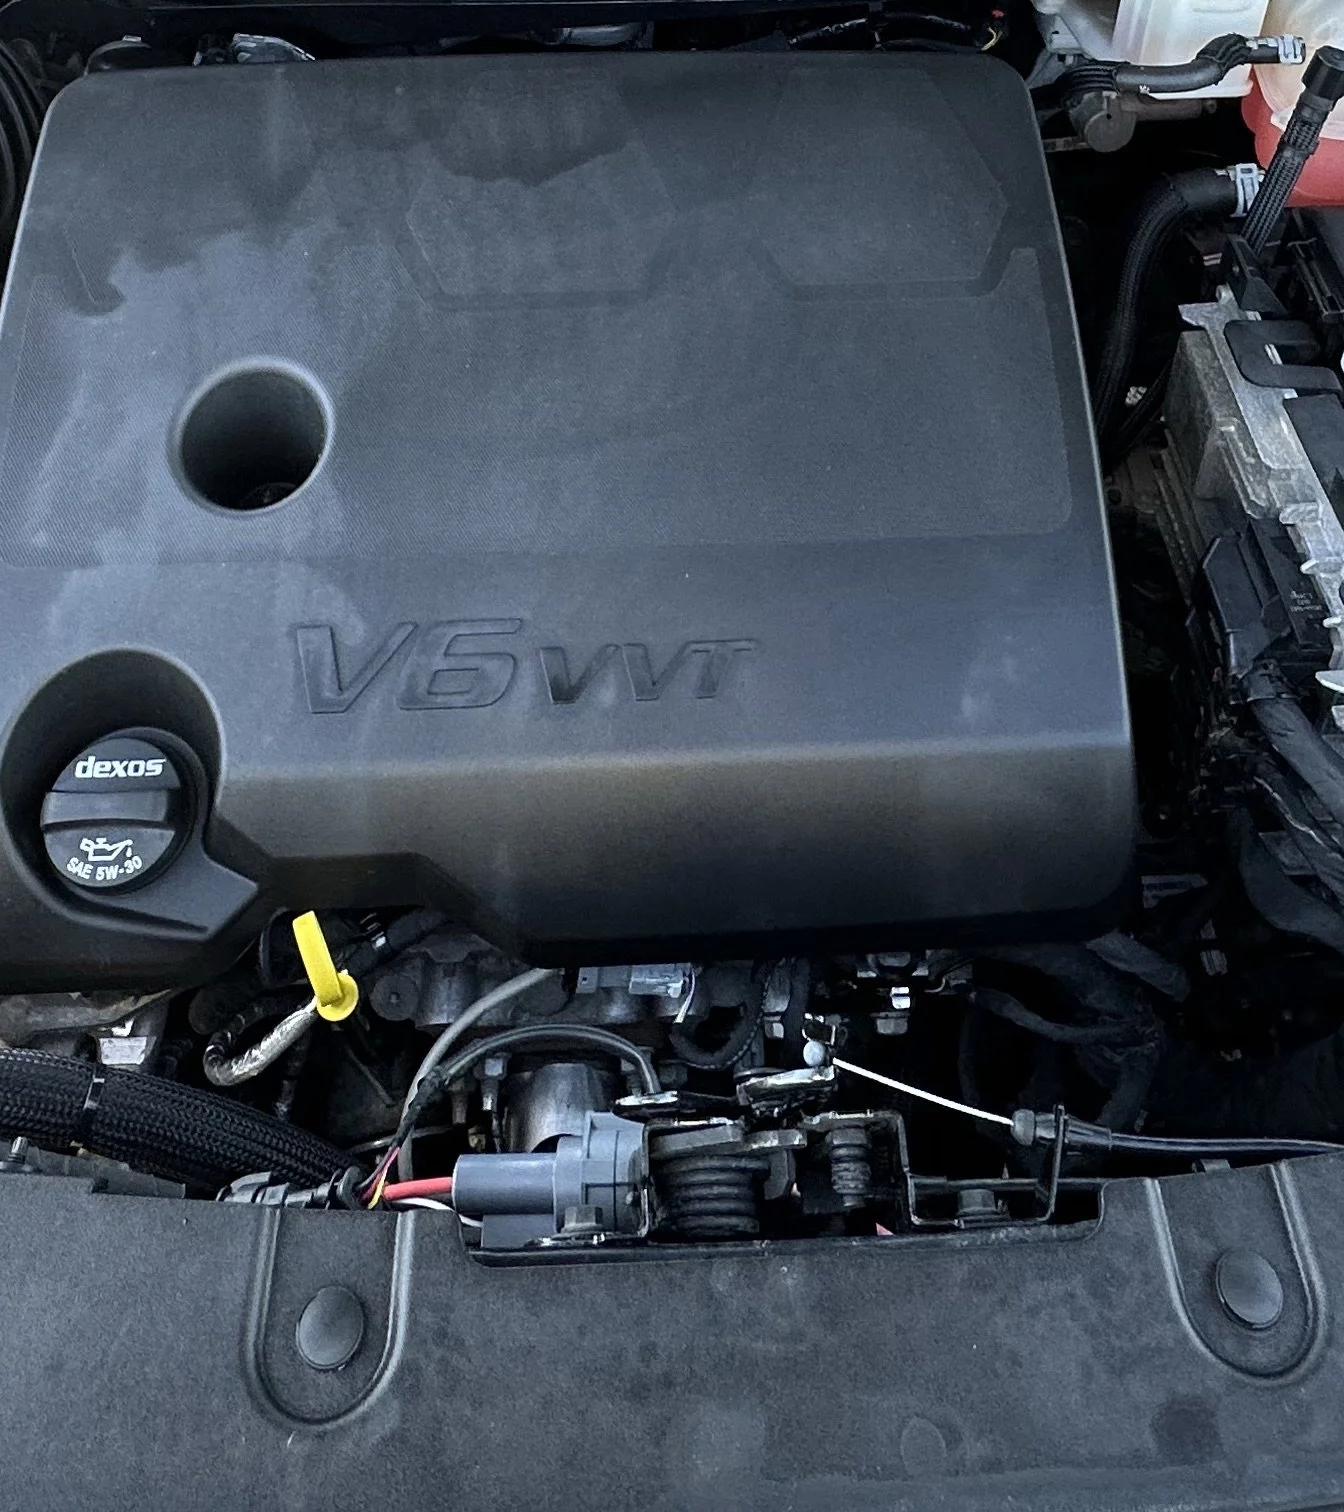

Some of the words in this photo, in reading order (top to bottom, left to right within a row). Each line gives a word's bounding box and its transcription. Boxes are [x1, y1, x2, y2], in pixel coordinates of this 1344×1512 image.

[294, 617, 524, 714] V6
[538, 638, 758, 705] VVT
[74, 755, 167, 779] dexos
[66, 856, 94, 880] SAE
[96, 855, 143, 881] 5W-30
